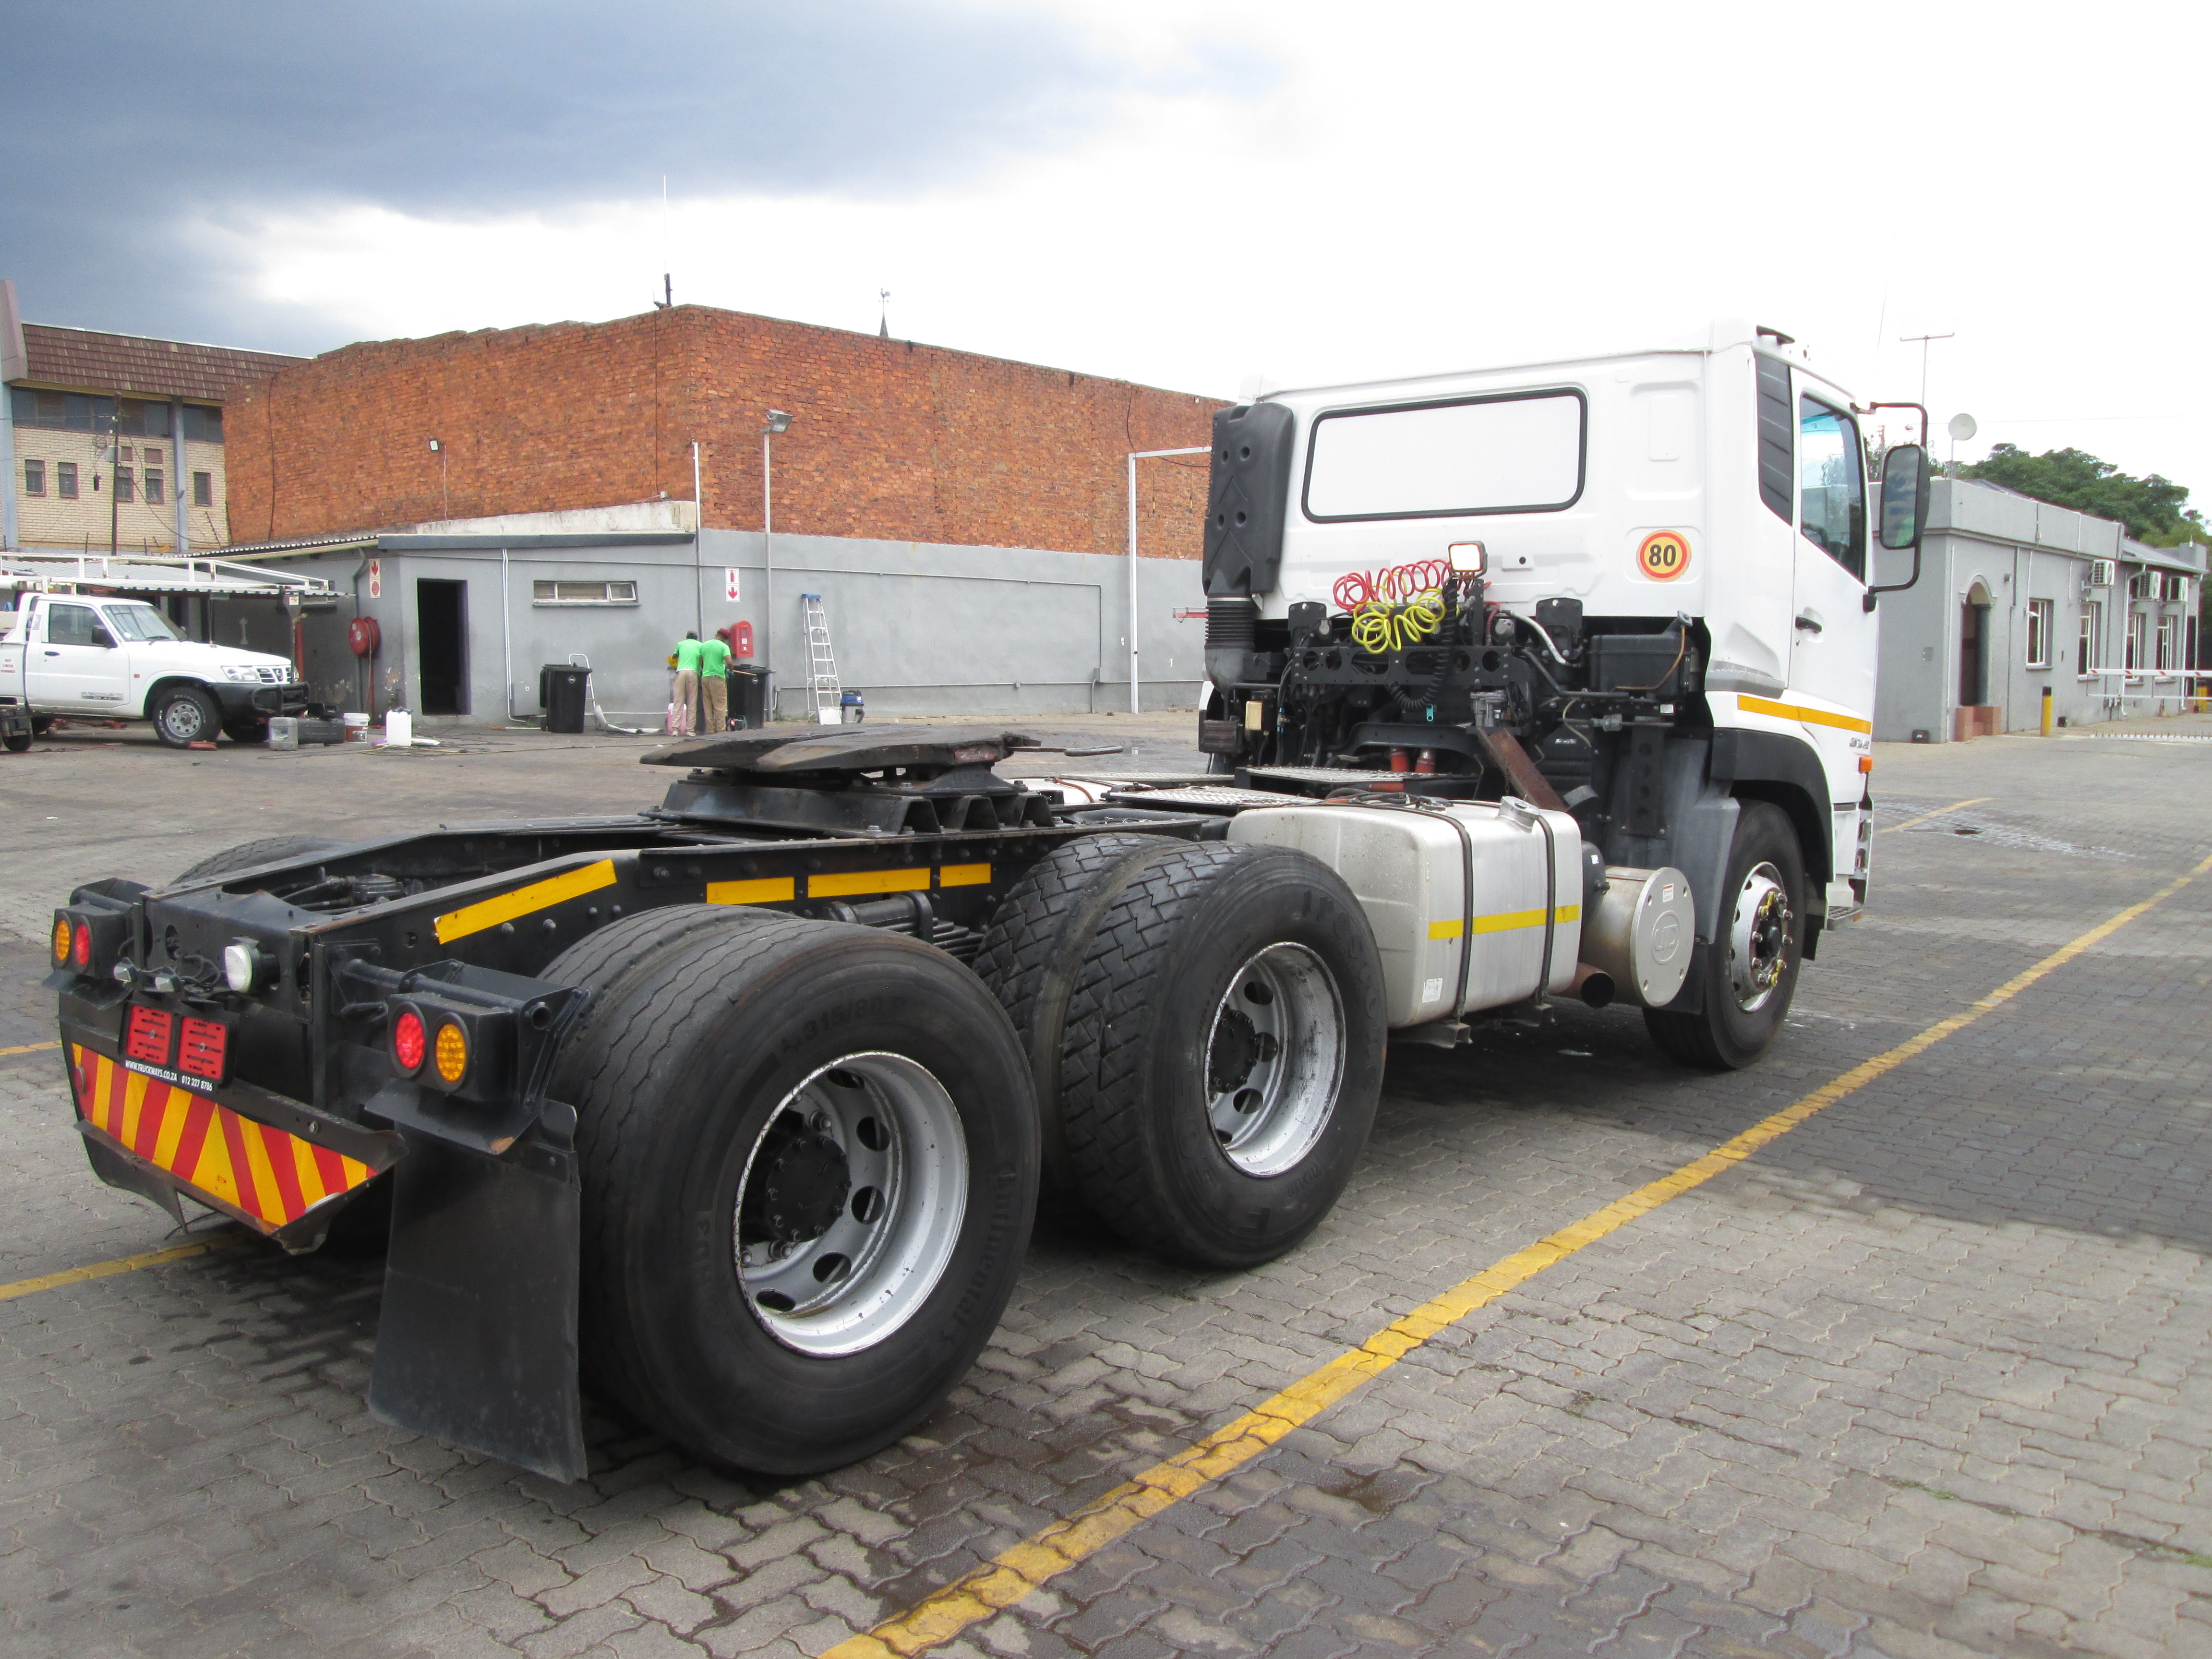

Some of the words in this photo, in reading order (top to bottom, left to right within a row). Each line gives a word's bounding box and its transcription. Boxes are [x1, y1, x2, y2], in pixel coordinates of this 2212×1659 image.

[1648, 544, 1676, 566] 80
[125, 1059, 178, 1082] WWW.TRUCKWAYS.CO.ZA
[181, 1075, 191, 1086] 012
[191, 1078, 201, 1088] 327
[200, 1080, 213, 1092] 8786
